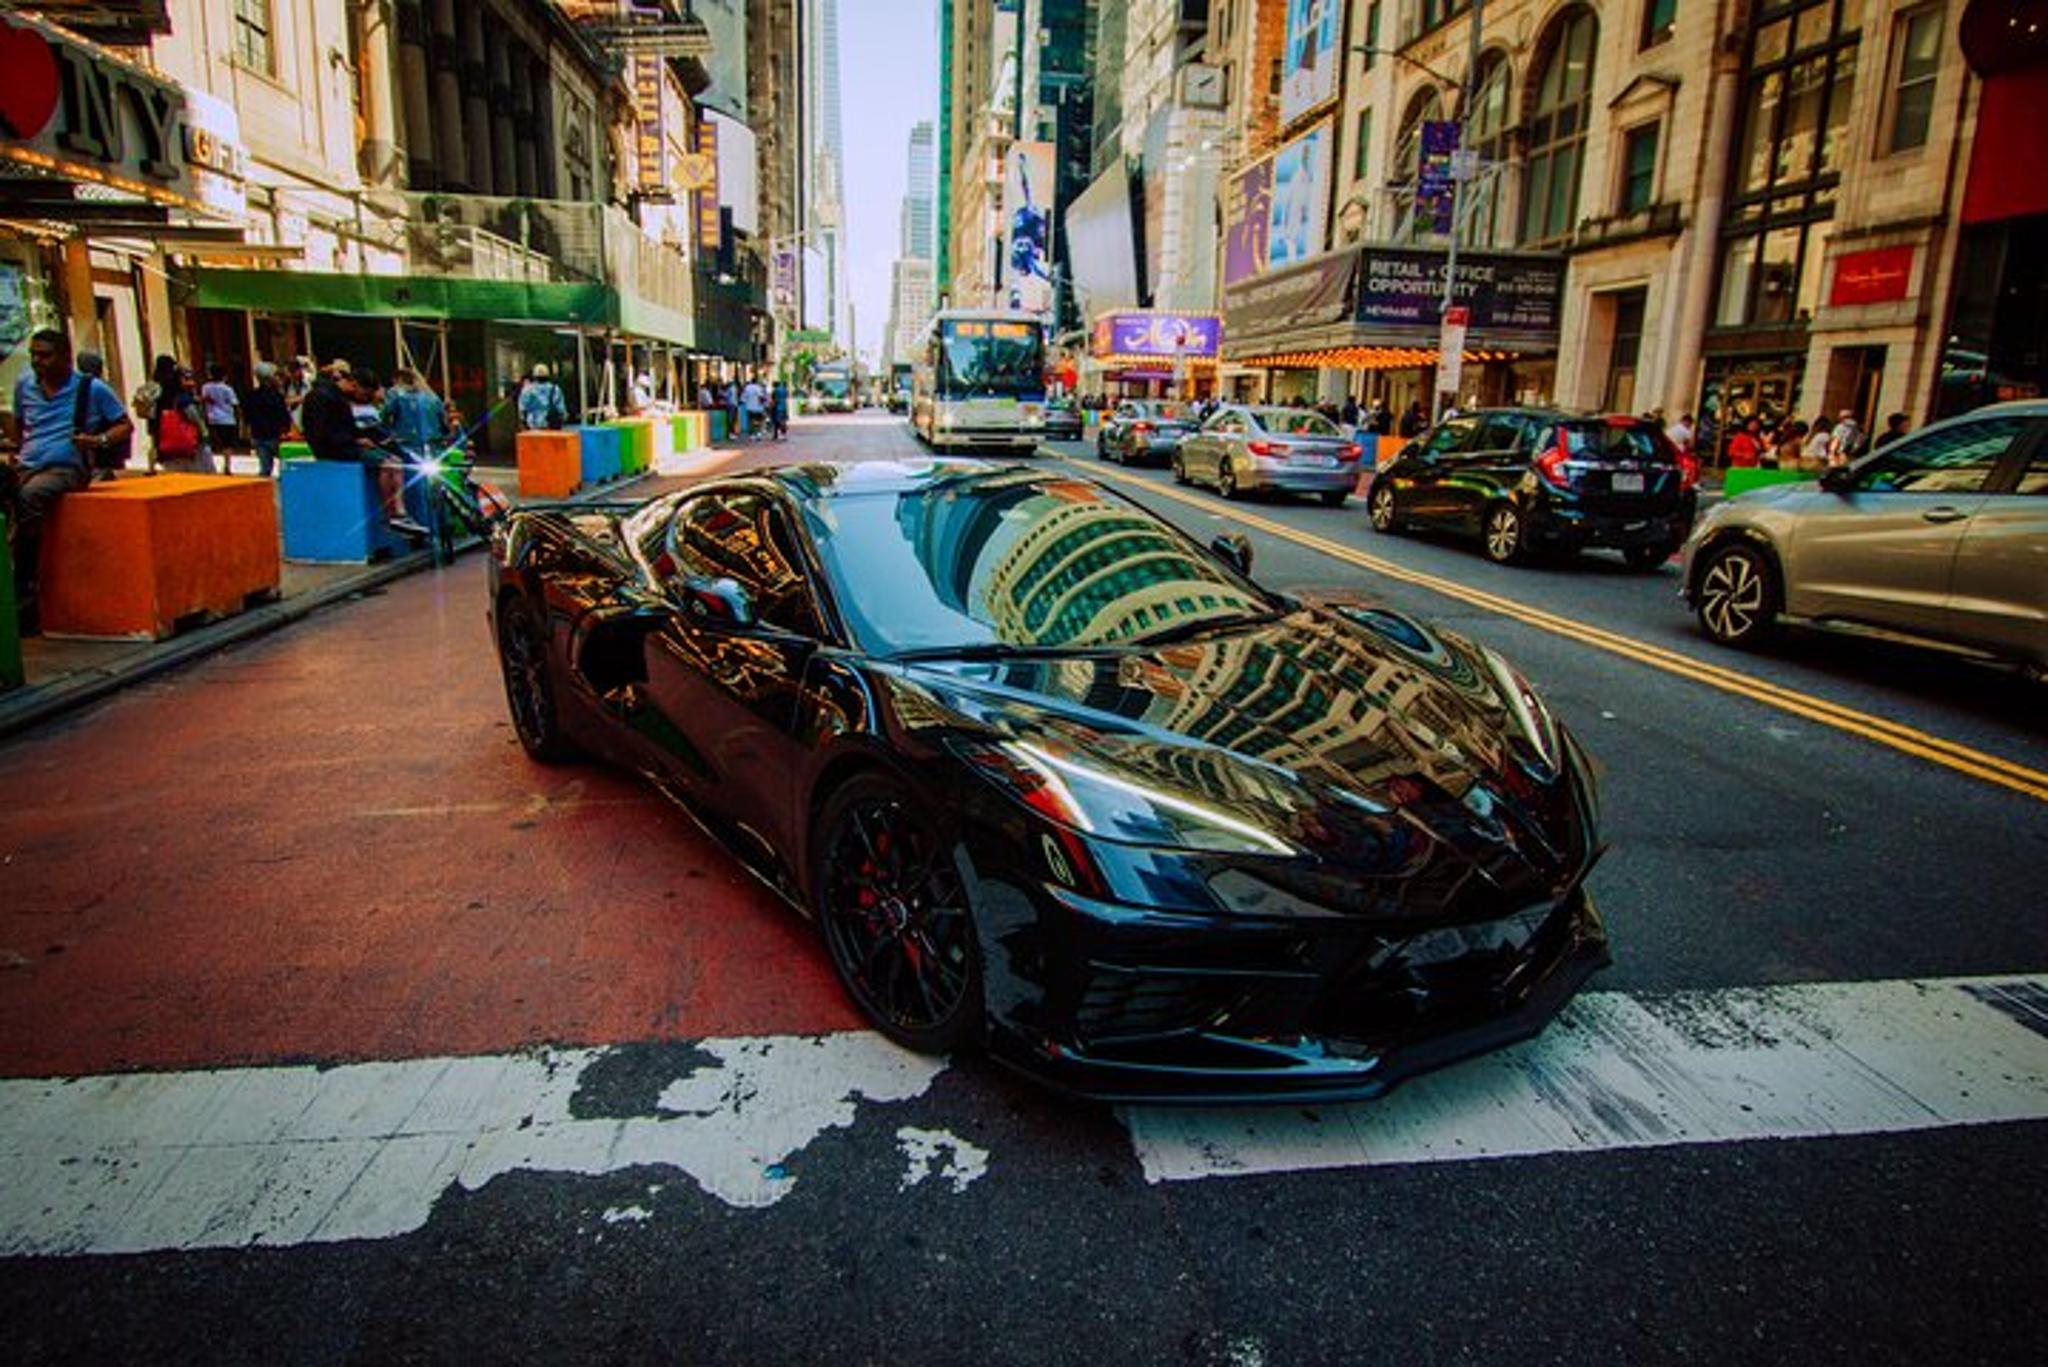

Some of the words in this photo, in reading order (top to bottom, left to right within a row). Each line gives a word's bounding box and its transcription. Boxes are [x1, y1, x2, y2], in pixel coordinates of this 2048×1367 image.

[57, 44, 185, 181] NY
[1369, 261, 1422, 277] RETAIL
[1369, 278, 1479, 297] OPPORTUITY
